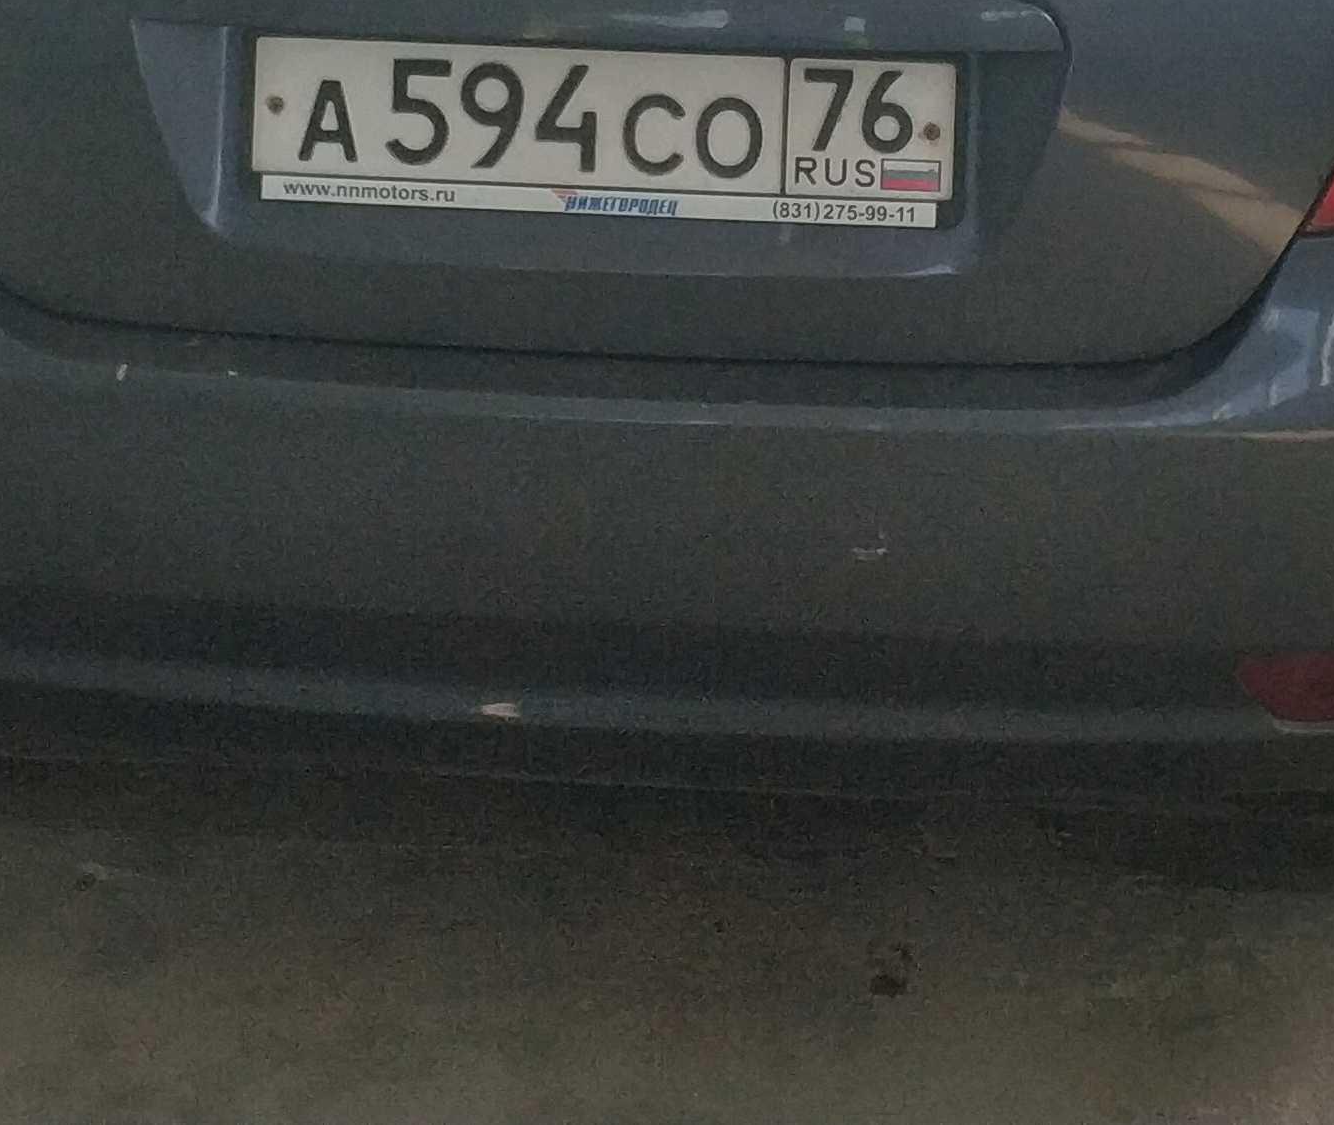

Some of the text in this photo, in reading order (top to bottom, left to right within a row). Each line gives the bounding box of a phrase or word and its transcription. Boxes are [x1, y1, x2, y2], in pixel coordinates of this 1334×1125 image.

[802, 68, 915, 154] 76
[794, 156, 876, 188] RUS
[282, 181, 456, 203] www.nnmotors.ru
